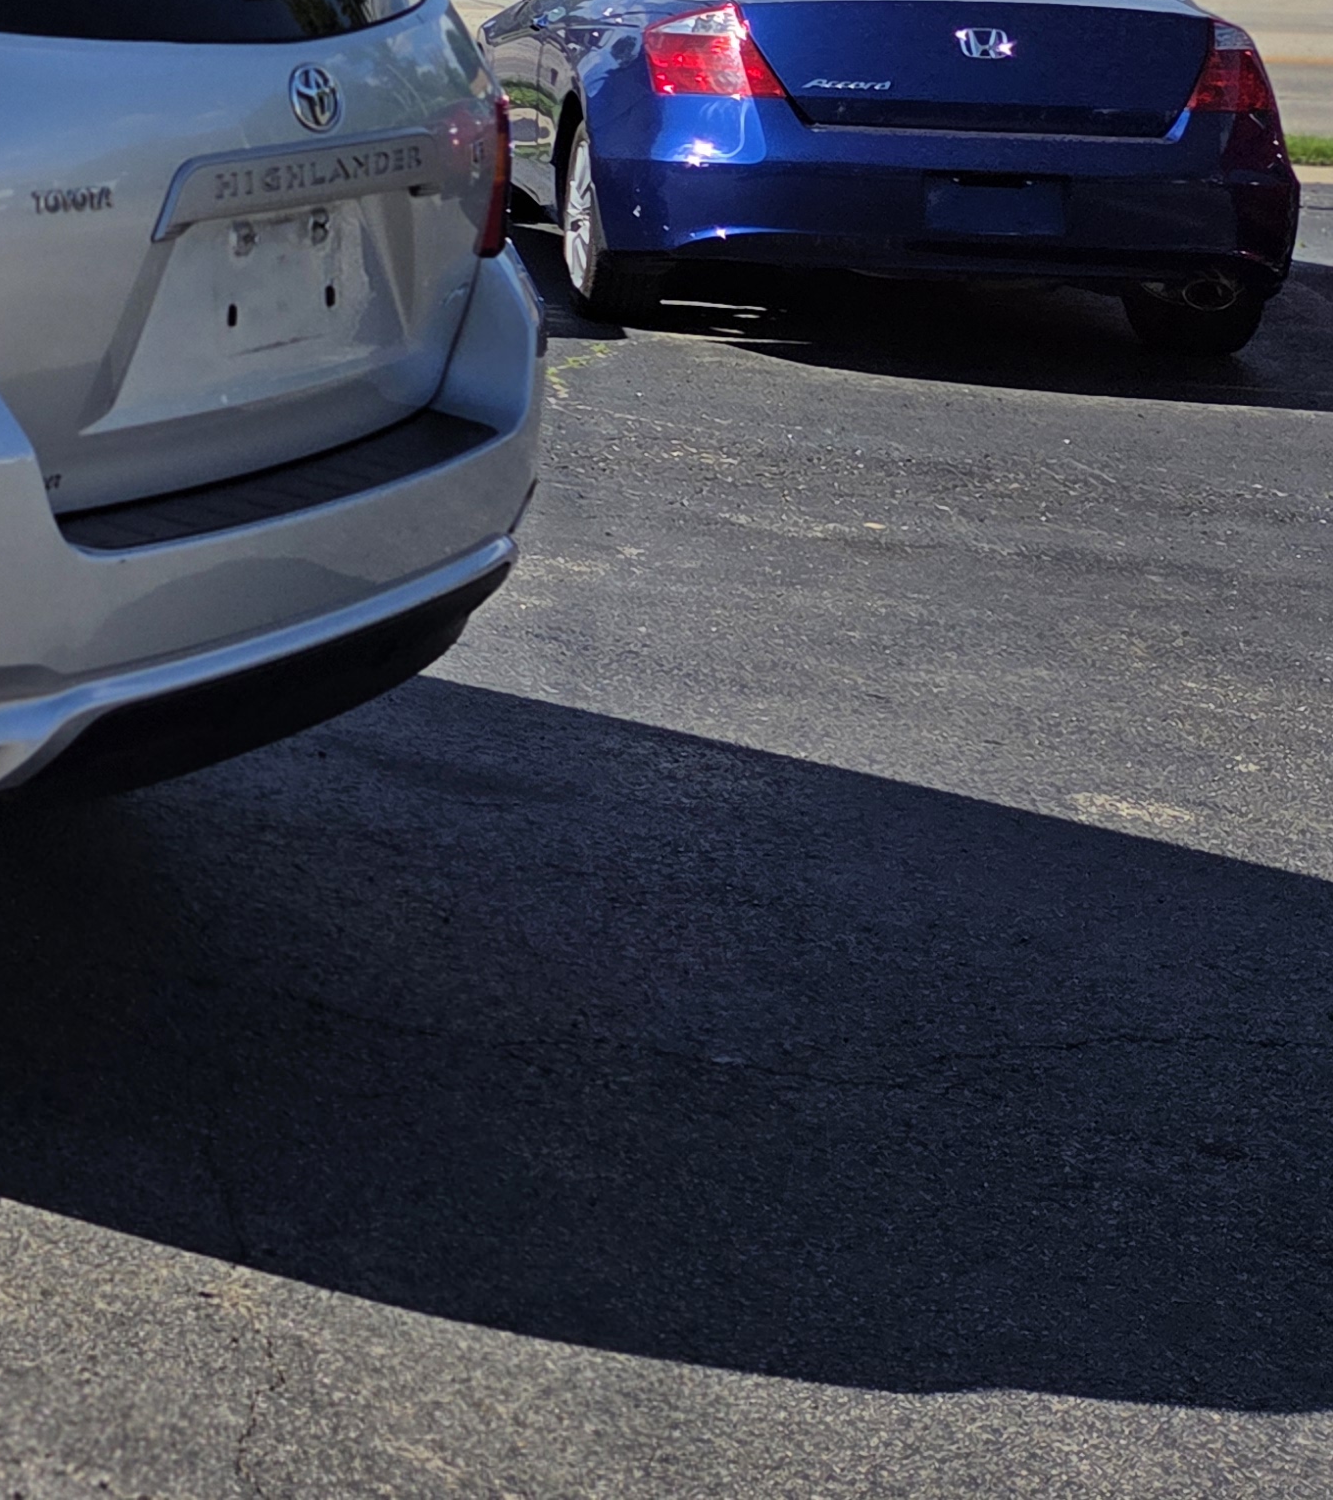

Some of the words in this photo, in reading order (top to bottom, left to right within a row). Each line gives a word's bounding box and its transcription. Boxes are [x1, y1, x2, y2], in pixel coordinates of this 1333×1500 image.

[801, 78, 892, 91] Accord
[214, 145, 423, 200] HIGHLANDER
[30, 185, 113, 215] TOYOTA
